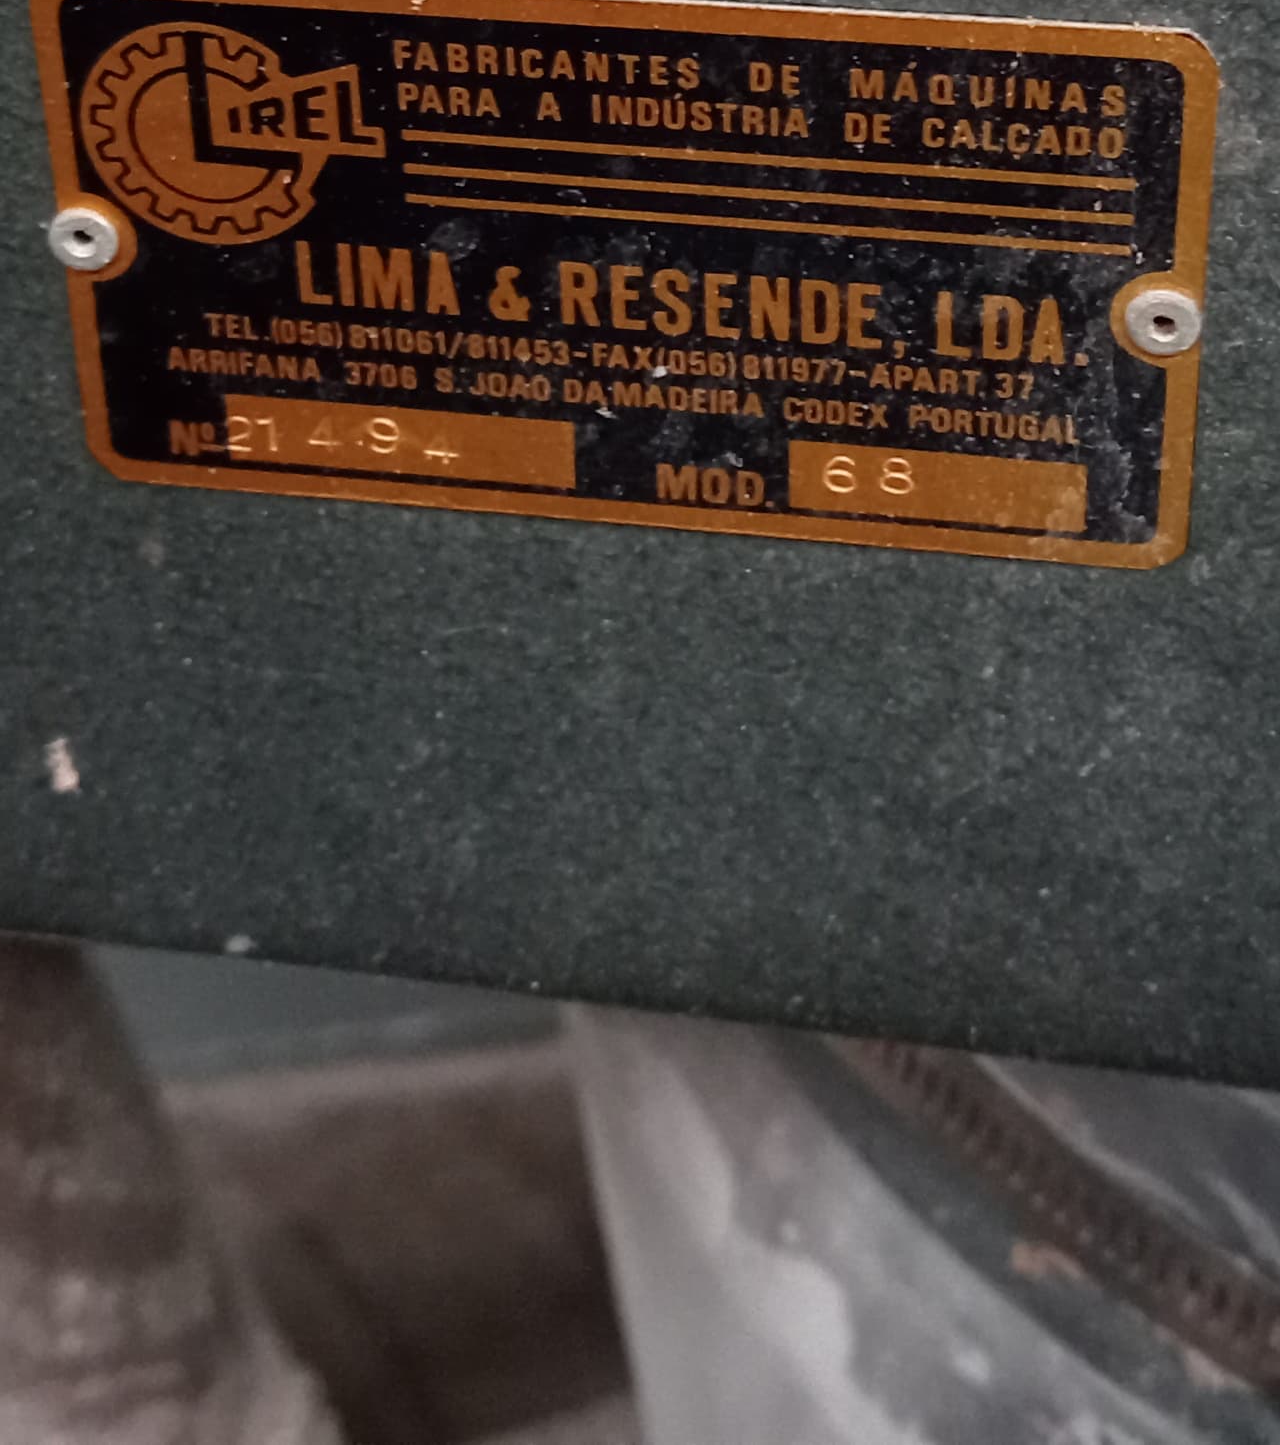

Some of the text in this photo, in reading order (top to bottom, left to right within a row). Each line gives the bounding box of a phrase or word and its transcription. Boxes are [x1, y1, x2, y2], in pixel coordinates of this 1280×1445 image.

[183, 30, 377, 170] LIREL
[392, 40, 1126, 118] FABRICANTES DE MÁQUINAS
[397, 83, 1125, 160] PARA A INDÚSTRIA DE CALÇADO
[295, 240, 1089, 368] LIMA & RESENDE, LDA.
[167, 346, 322, 382] ARRIFANA
[344, 359, 417, 390] 3706
[613, 381, 764, 418] MADEIRA
[783, 397, 889, 429] CODEX
[908, 404, 1080, 446] PORTUGAL
[655, 463, 774, 509] MOD.
